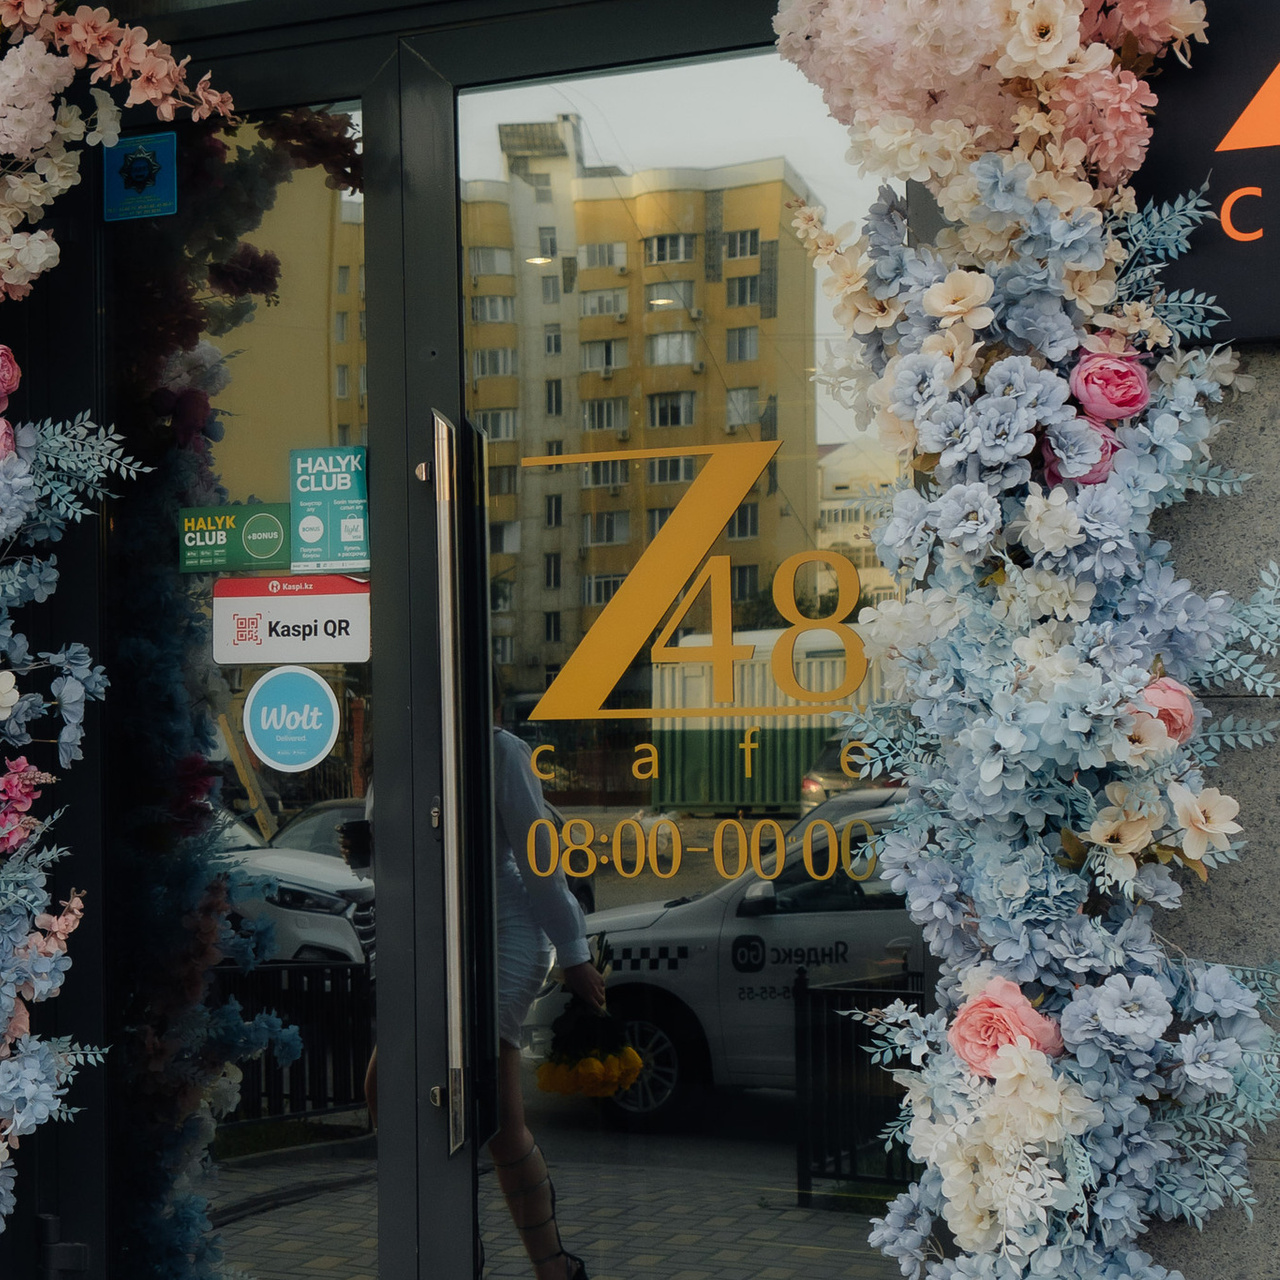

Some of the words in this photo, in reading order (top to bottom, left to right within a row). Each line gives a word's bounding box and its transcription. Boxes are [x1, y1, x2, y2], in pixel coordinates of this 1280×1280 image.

[296, 454, 362, 474] HALYK
[296, 473, 352, 492] CLUB
[184, 515, 236, 531] HALYK
[184, 530, 227, 546] CLUB
[282, 583, 314, 592] Kaspi.kz
[521, 440, 868, 720] Z48
[268, 619, 318, 641] Kaspi
[323, 619, 350, 638] QR
[261, 704, 323, 730] Wolt
